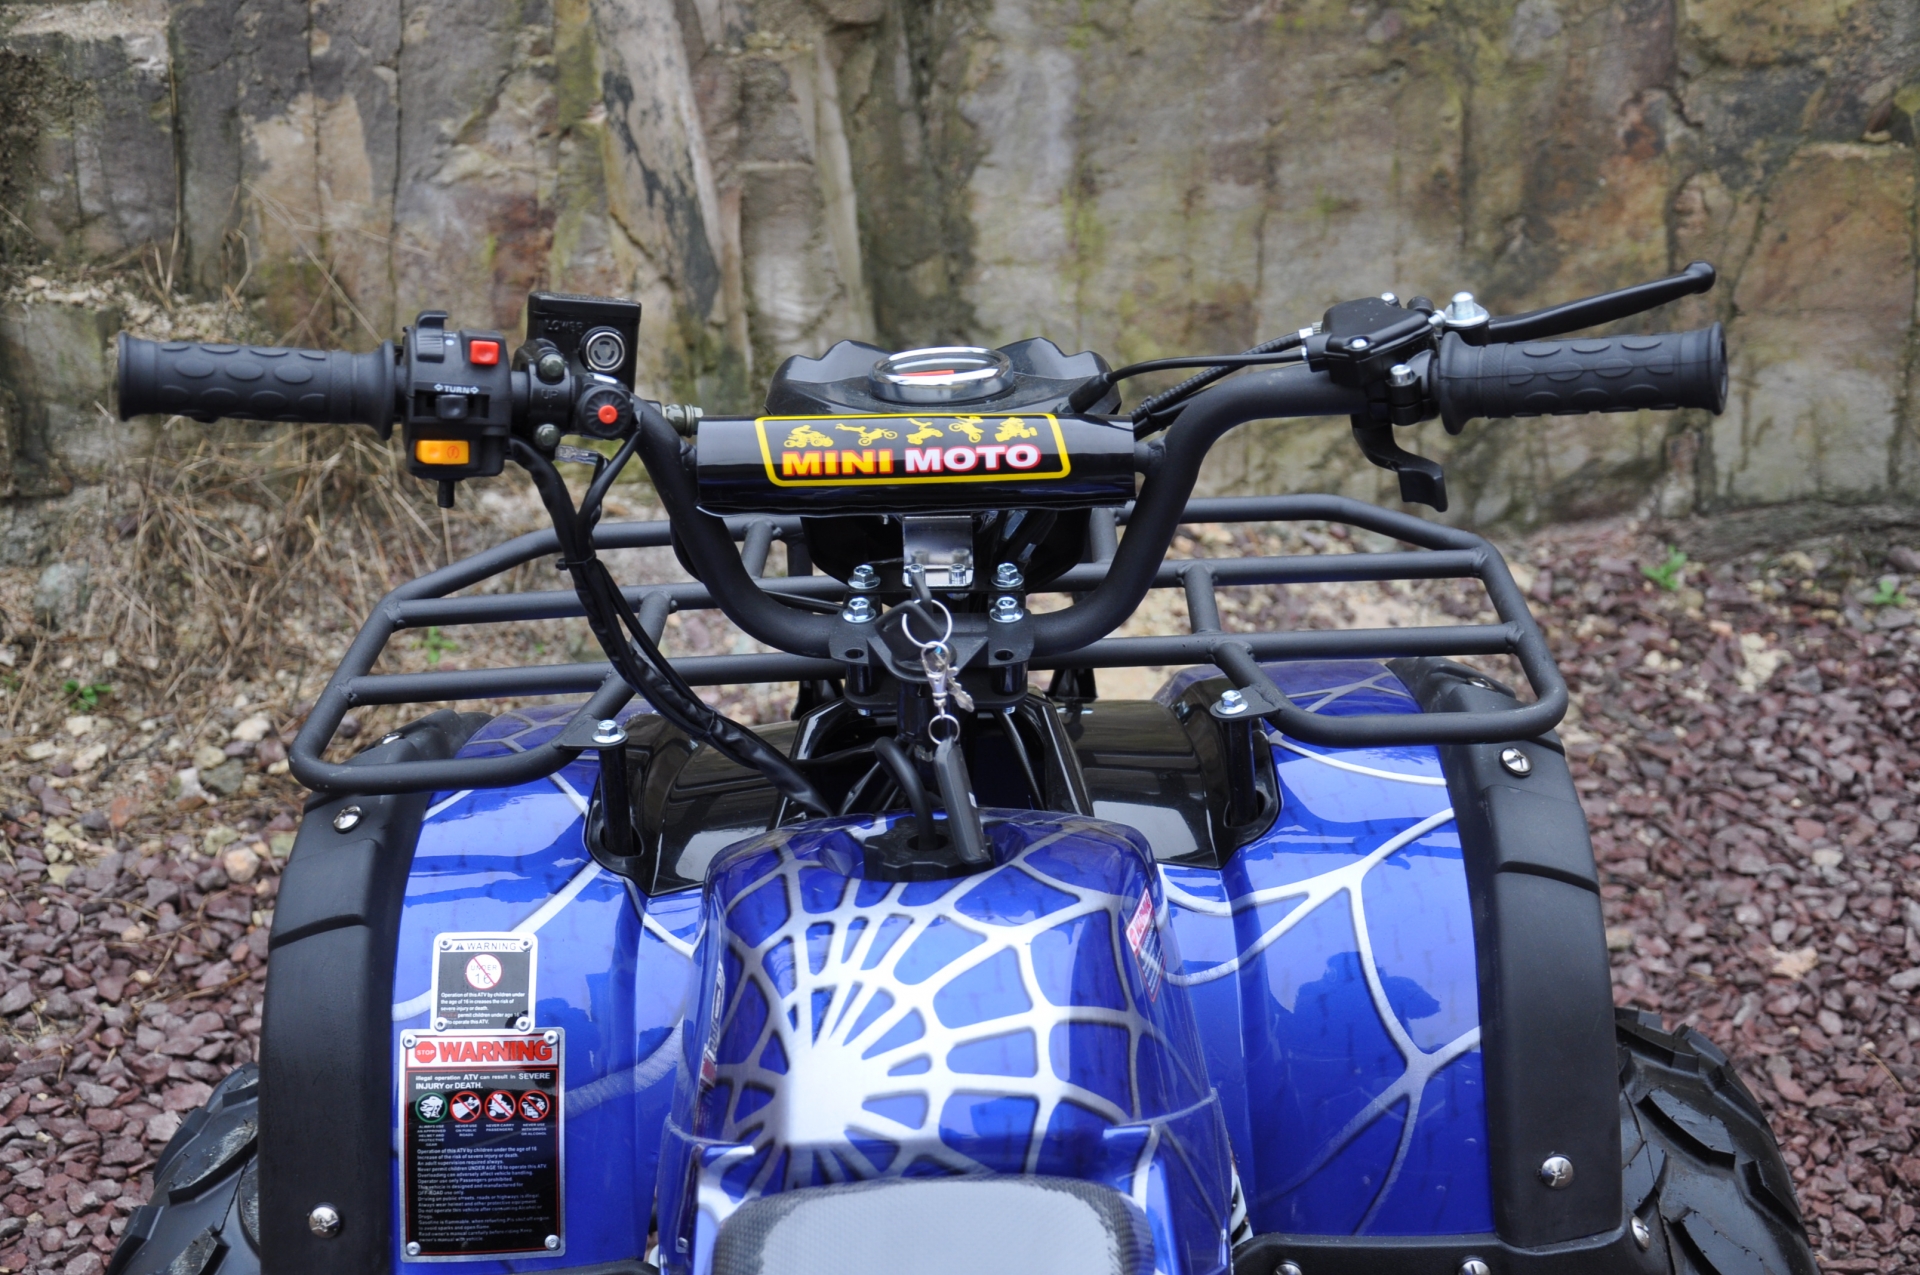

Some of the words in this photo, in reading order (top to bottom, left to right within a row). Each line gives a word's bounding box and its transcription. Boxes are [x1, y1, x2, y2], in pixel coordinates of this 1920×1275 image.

[444, 384, 471, 394] TURN
[541, 388, 558, 400] UP
[782, 448, 894, 476] MINI
[904, 443, 1042, 472] MOTO
[467, 942, 516, 950] WARNING
[475, 973, 492, 984] 16
[438, 1040, 552, 1062] WARNING
